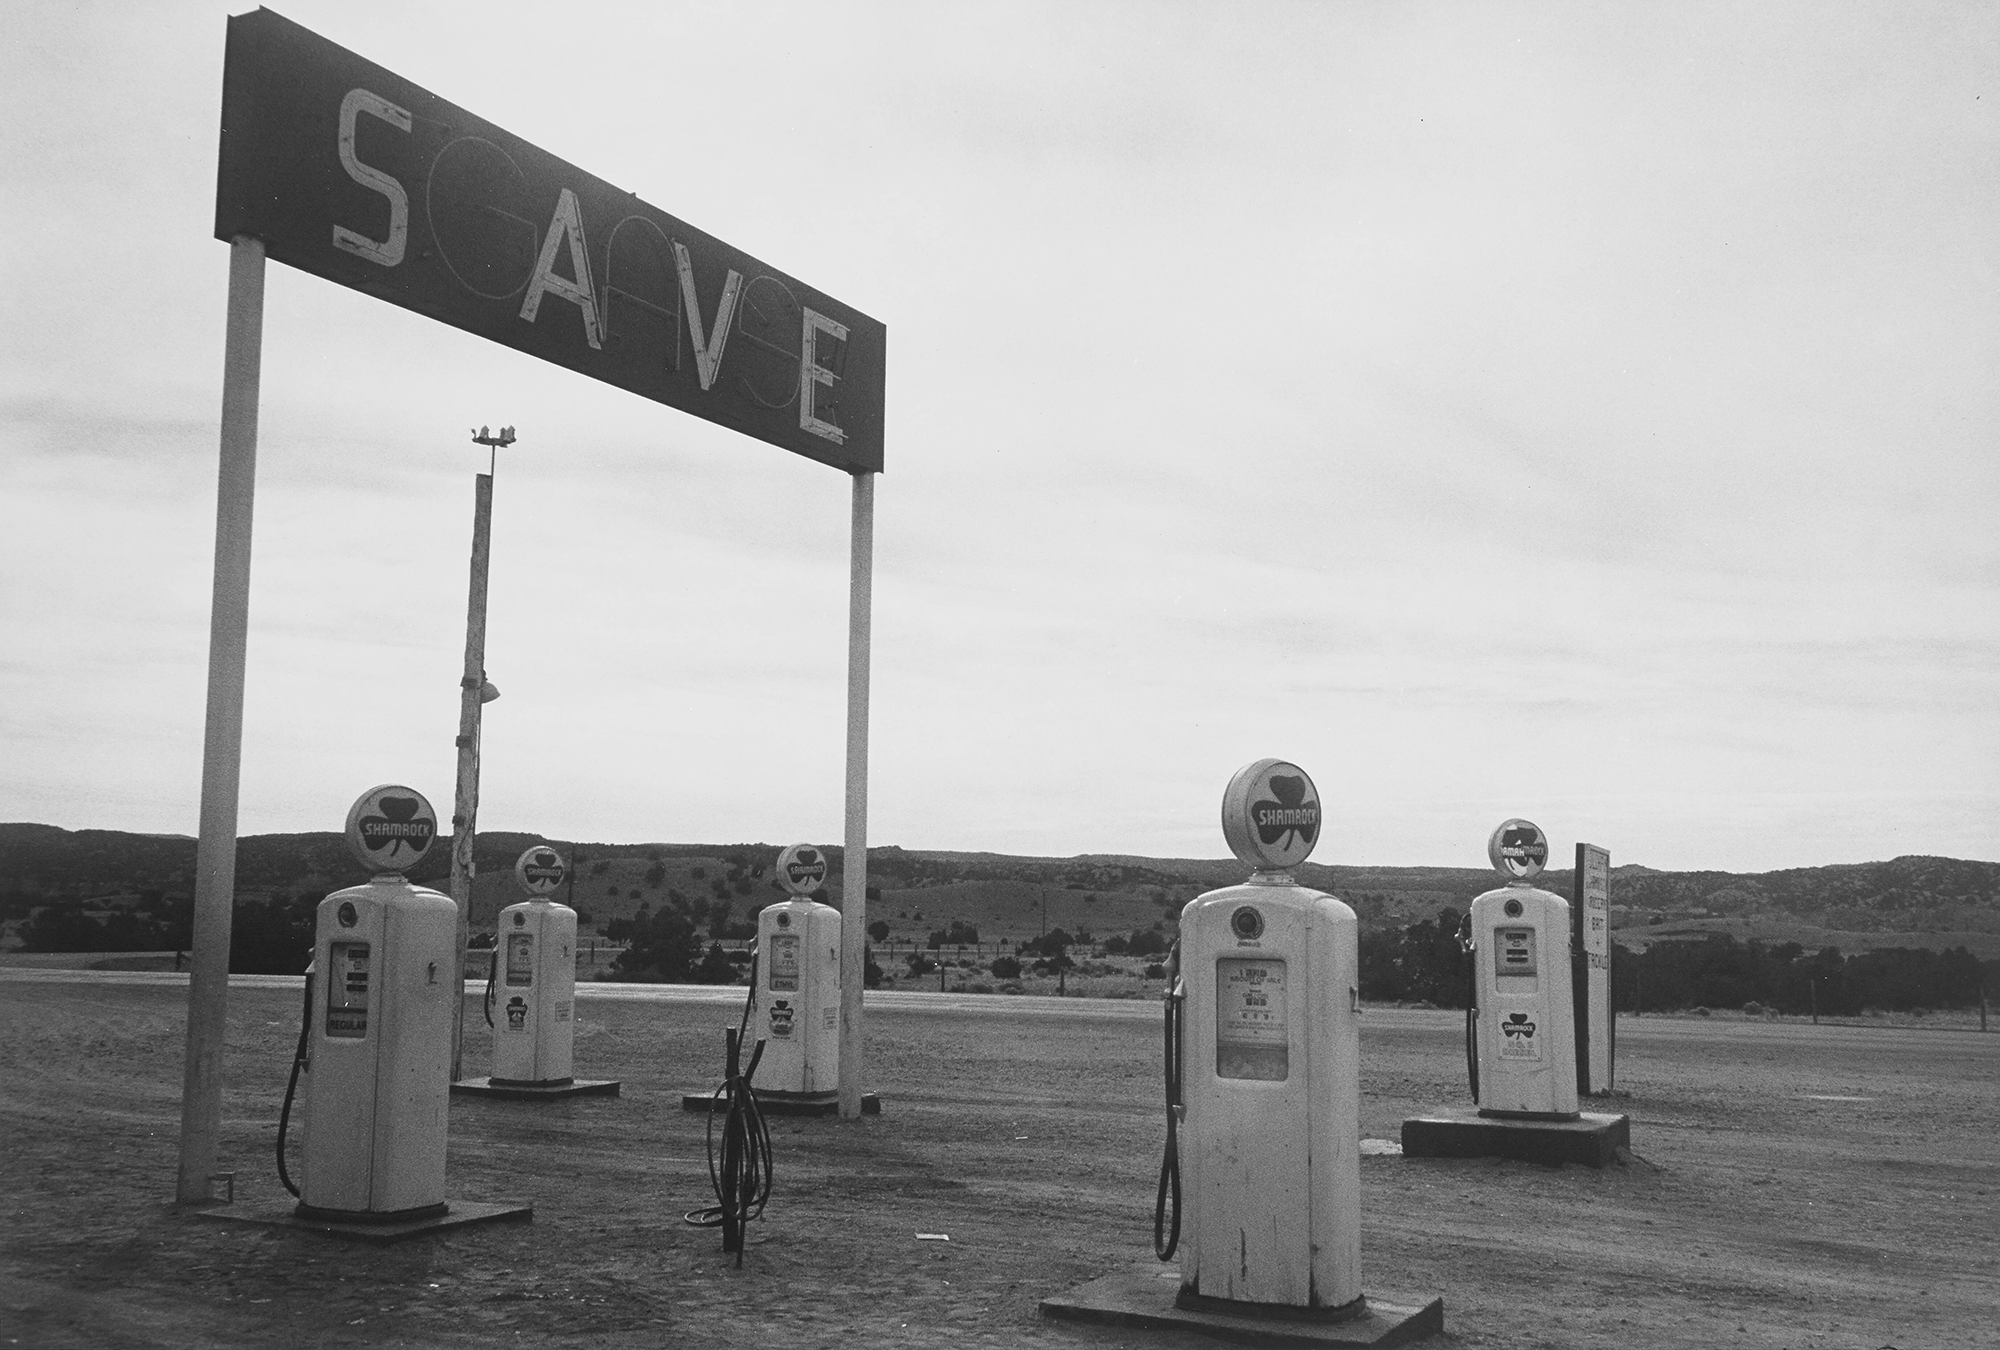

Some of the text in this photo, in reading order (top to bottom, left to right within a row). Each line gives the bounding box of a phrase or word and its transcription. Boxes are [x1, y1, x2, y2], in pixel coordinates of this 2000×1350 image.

[333, 87, 851, 444] SAVE
[1258, 808, 1317, 826] SHAMROCK
[365, 822, 431, 837] SHAMROCK
[527, 867, 562, 877] SHAMROCK
[790, 865, 824, 875] SHAMROCK
[329, 1020, 367, 1031] REGULAR
